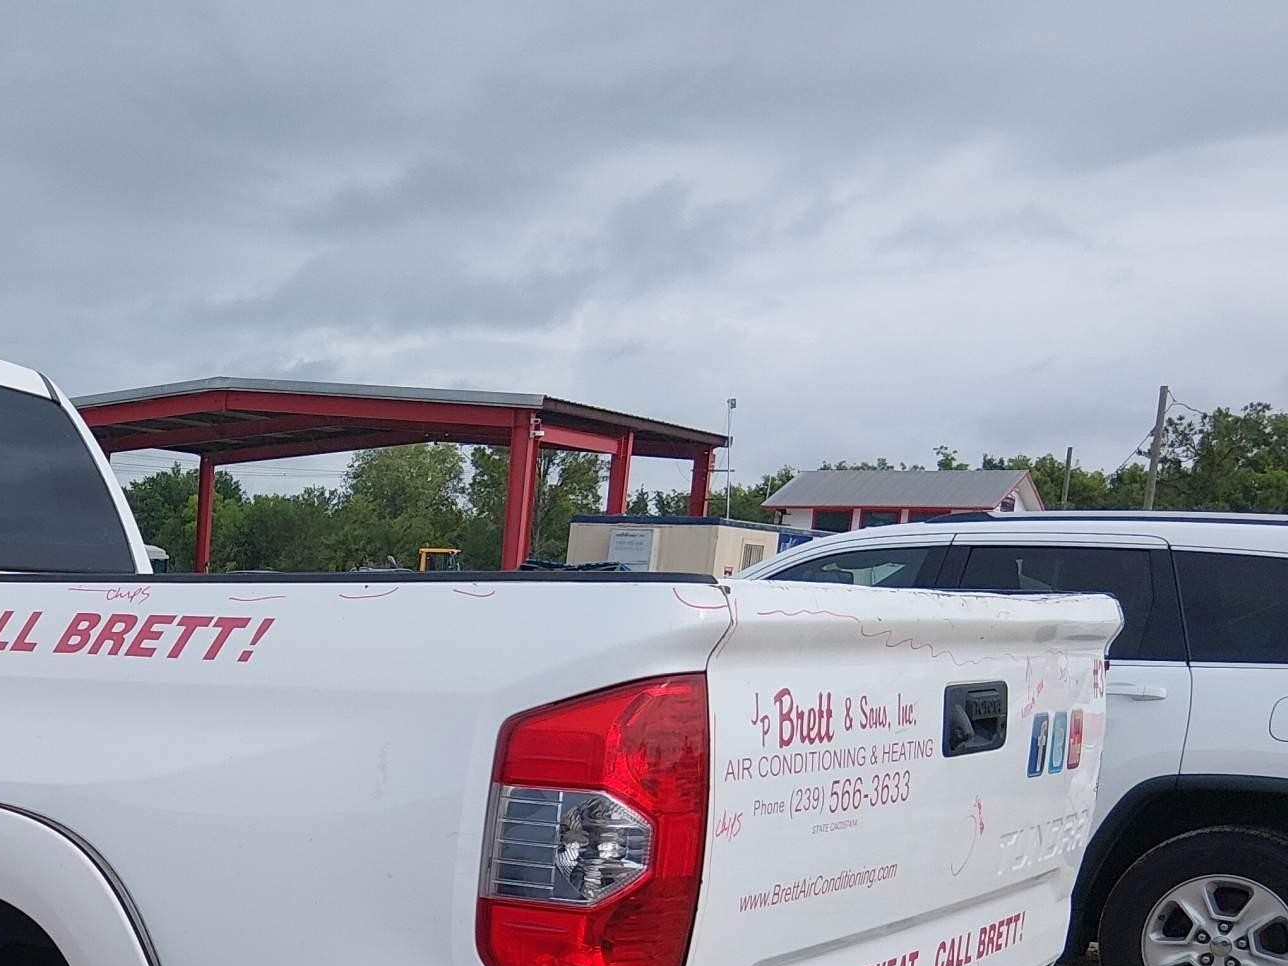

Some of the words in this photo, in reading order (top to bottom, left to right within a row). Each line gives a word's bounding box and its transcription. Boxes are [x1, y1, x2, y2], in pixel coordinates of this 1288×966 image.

[52, 612, 275, 663] BRETT!
[774, 687, 835, 748] Brett
[844, 696, 854, 731] &
[860, 695, 892, 731] Sons,
[897, 692, 918, 727] Inc.
[724, 757, 753, 782] AIR
[758, 746, 866, 778] CONDITIONING
[870, 744, 878, 765] &
[882, 738, 934, 764] HEATING
[753, 799, 785, 817] Phone
[789, 785, 825, 819] (239)
[829, 770, 911, 814] 566-3633
[739, 863, 898, 912] www.BrettAirConditioning.com
[976, 910, 1026, 959] BRETT!
